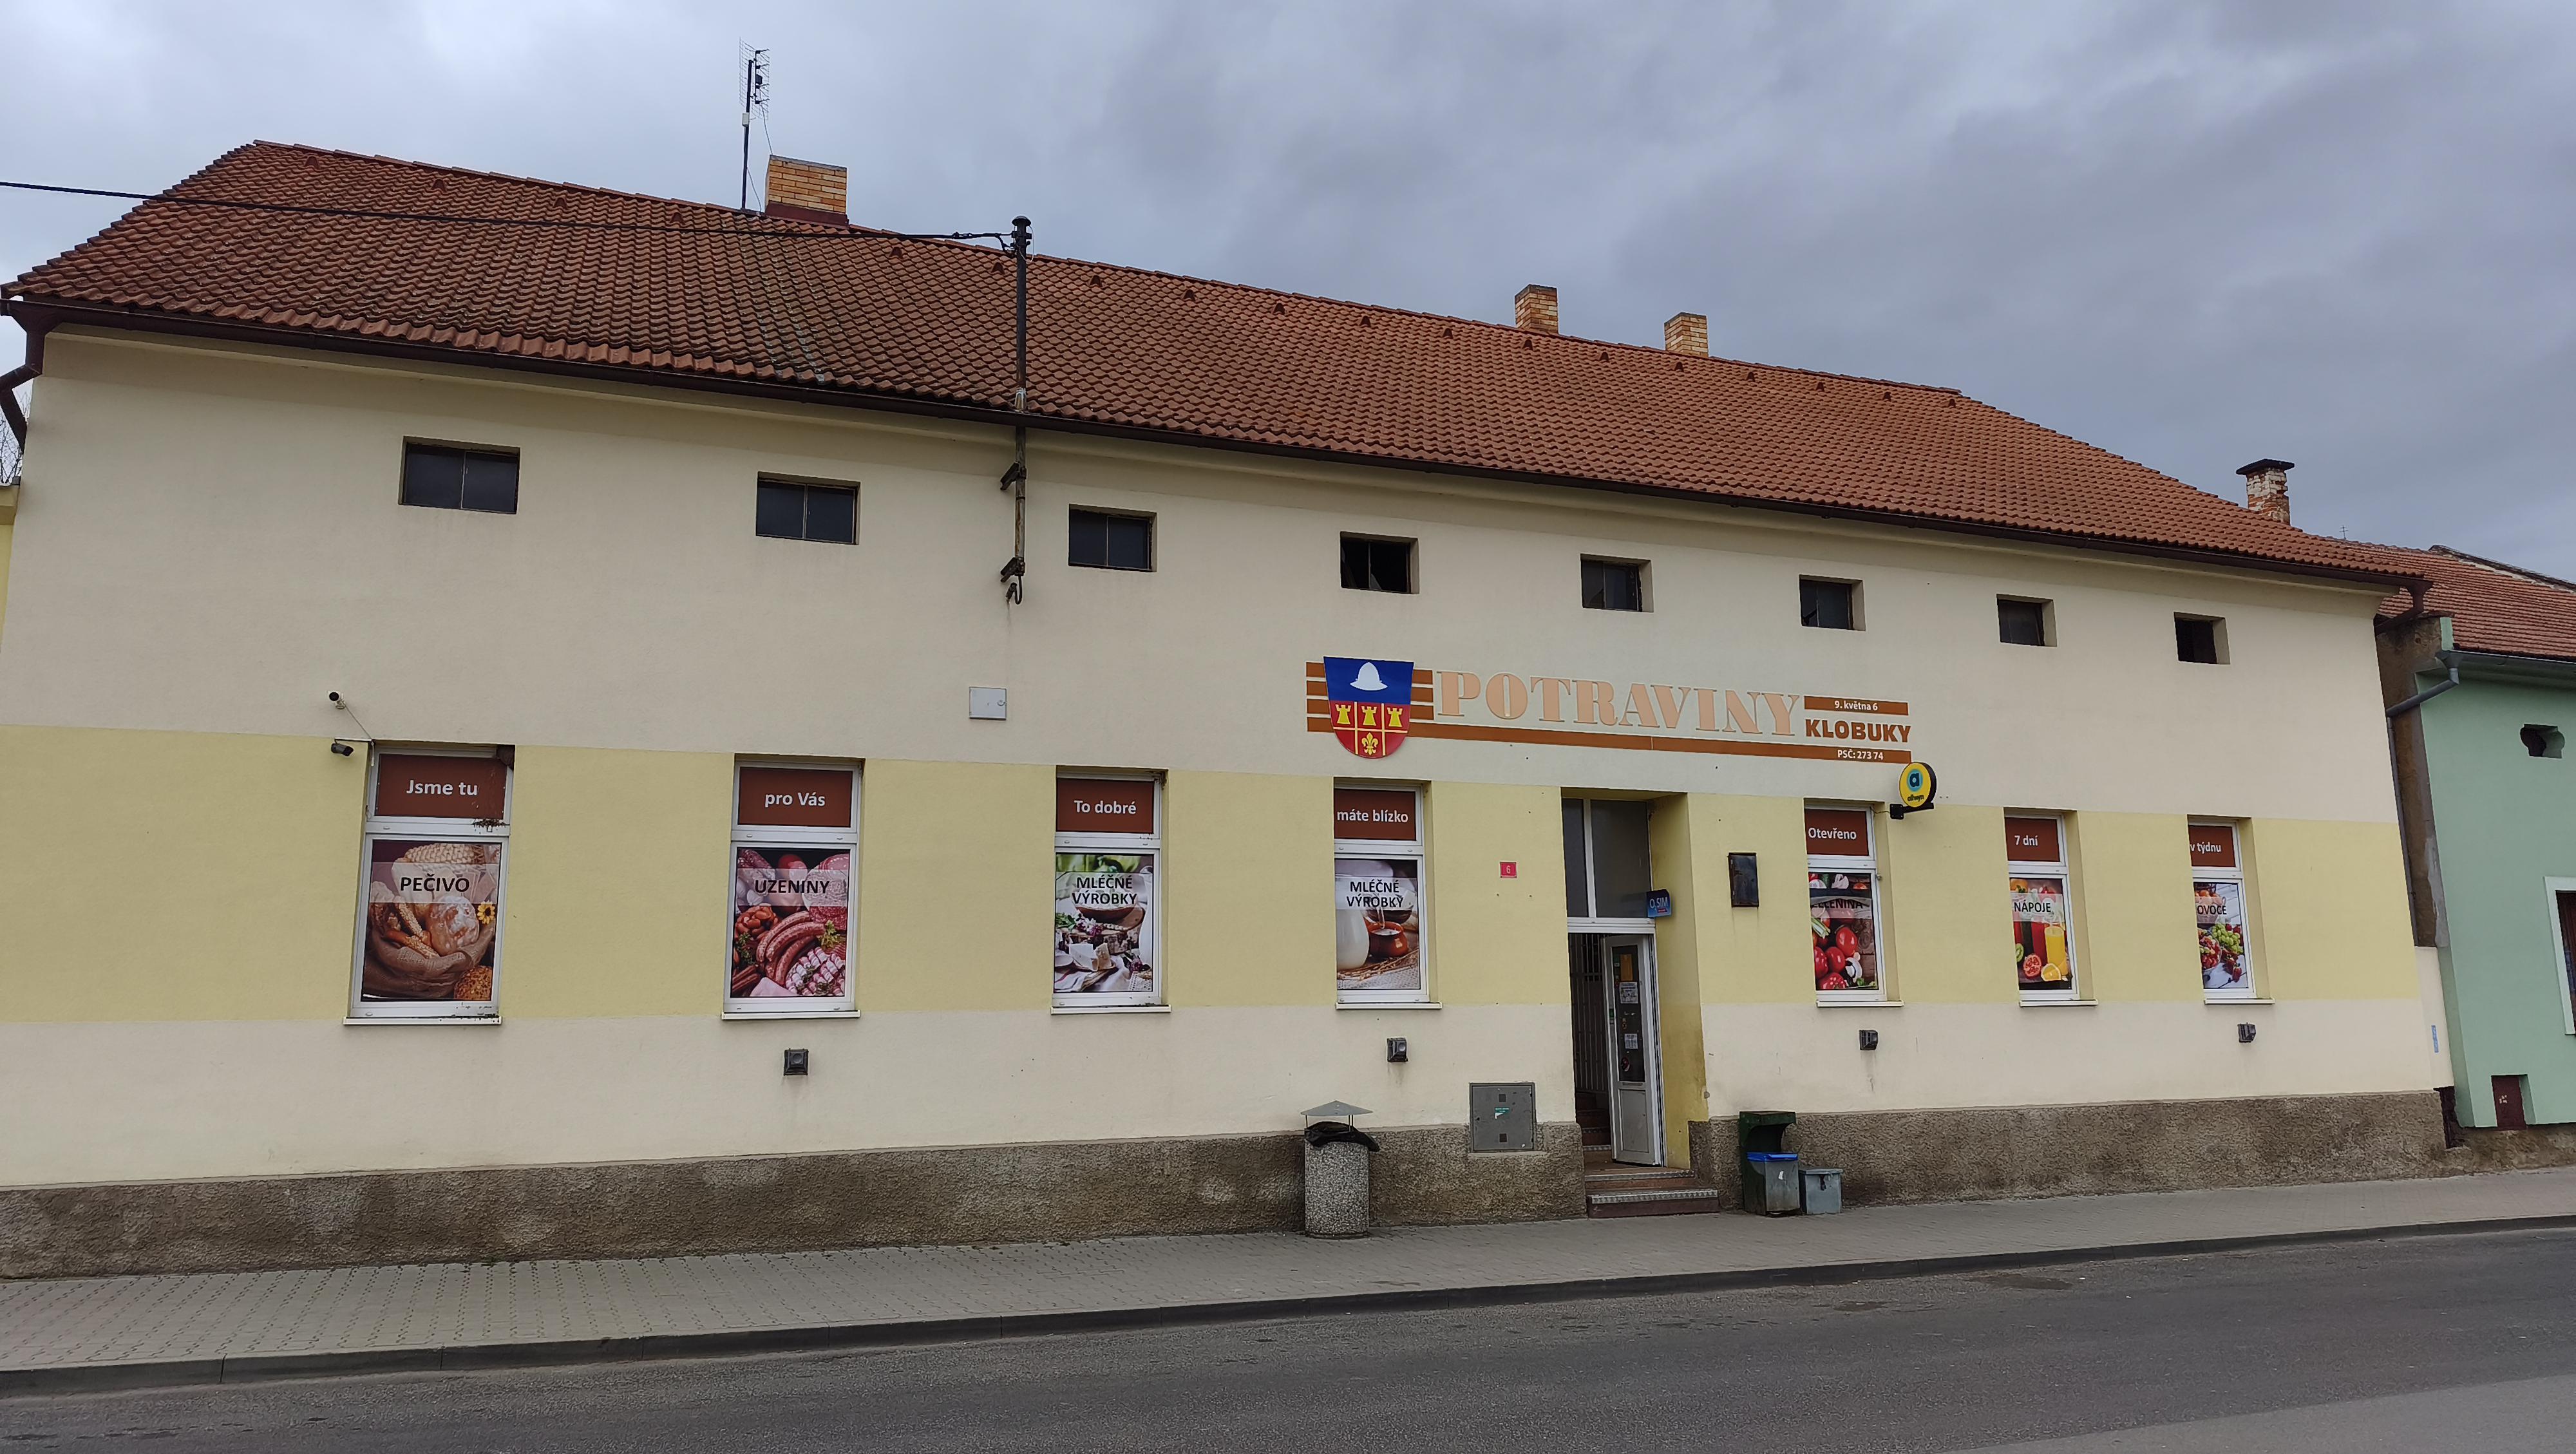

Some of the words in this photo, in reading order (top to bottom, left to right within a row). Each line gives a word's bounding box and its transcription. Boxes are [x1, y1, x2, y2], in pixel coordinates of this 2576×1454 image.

[1436, 670, 1801, 736] POTRAVINY
[1834, 700, 1842, 709] 9.
[1844, 700, 1871, 711] května
[1872, 703, 1878, 711] 6
[1805, 719, 1911, 742] KLOBUKY
[1837, 748, 1855, 759] PSČ:
[1857, 751, 1871, 760] 273
[1873, 751, 1884, 760] 74
[406, 780, 453, 795] Jsme
[459, 782, 478, 796] tu
[764, 793, 793, 807] pro
[797, 792, 826, 806] Vás
[1074, 800, 1090, 813] To
[1095, 800, 1137, 815] dobré
[1337, 809, 1369, 822] máte
[1372, 809, 1409, 823] blízko
[1808, 827, 1857, 840] Otevřeno
[2014, 835, 2020, 845] 7
[2023, 835, 2038, 846] dní
[2197, 842, 2222, 854] týdnu
[1506, 865, 1511, 874] 6
[400, 873, 470, 892] PEČIVO
[755, 880, 830, 894] UZENINY
[1076, 874, 1133, 889] MLÉČNÉ
[1350, 879, 1399, 893] MLÉČNÉ
[1072, 891, 1137, 905] VÝROBKY
[1346, 894, 1404, 908] VÝROBKY
[1656, 896, 1668, 908] SIM
[2014, 900, 2051, 912] NÁPOJE
[2197, 905, 2227, 915] OVOCE
